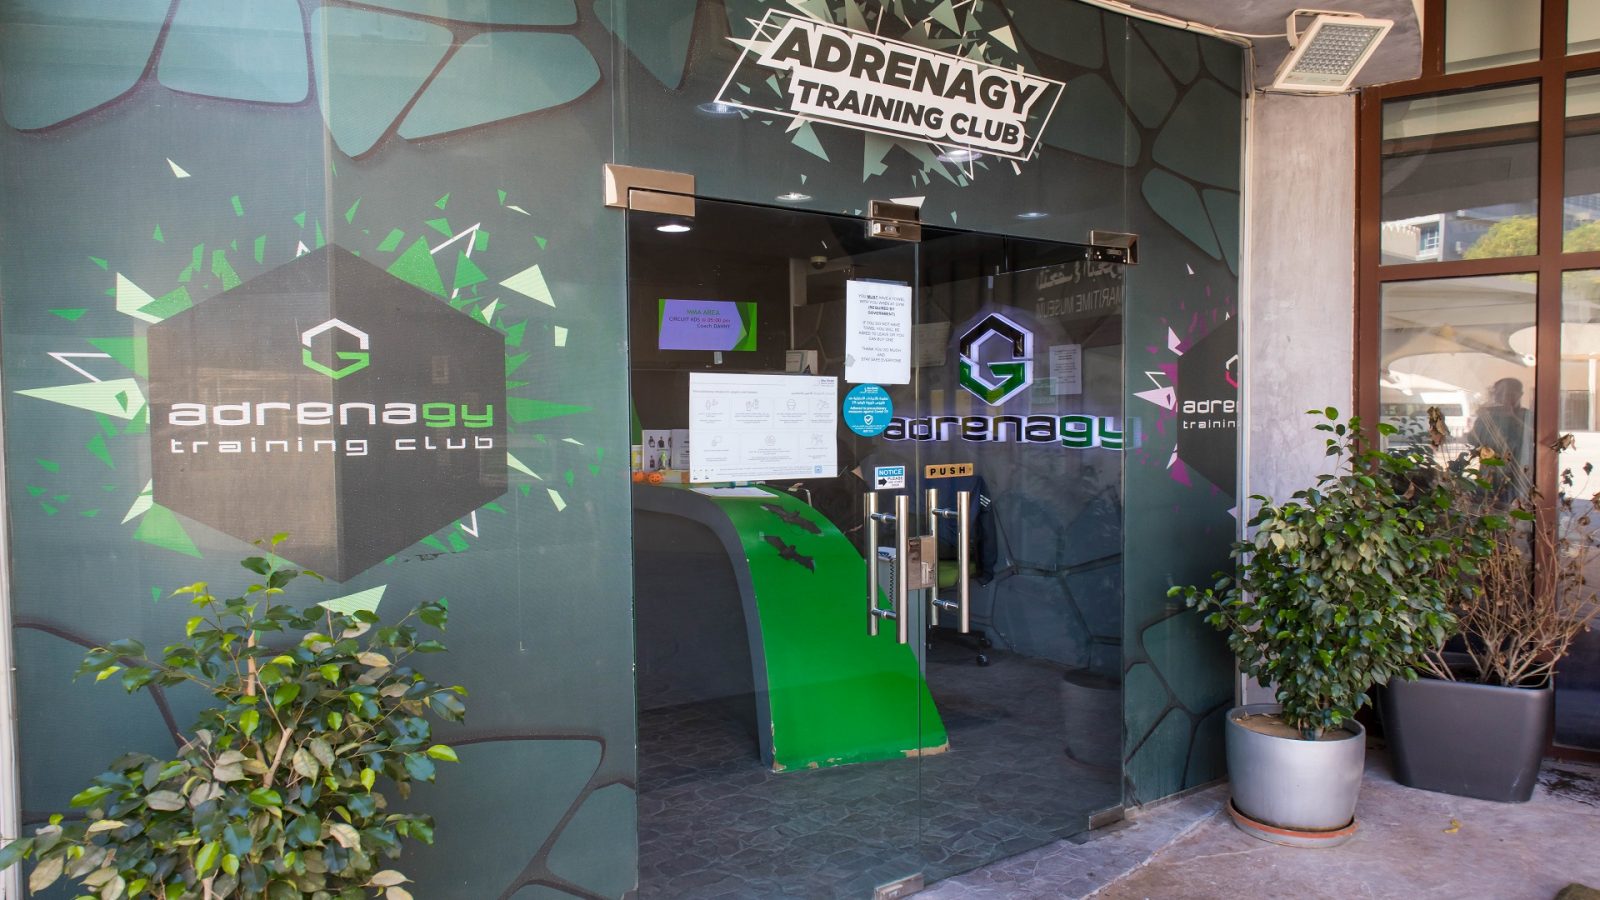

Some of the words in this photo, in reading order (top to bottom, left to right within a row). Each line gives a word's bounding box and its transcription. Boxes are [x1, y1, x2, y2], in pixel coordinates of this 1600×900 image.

[770, 25, 1039, 115] ADRENAGY
[797, 80, 944, 130] TRAINING
[950, 112, 1020, 145] CLUB
[168, 402, 494, 428] adrenagy
[1182, 400, 1238, 414] adre
[882, 414, 1141, 450] adrenagy
[170, 436, 368, 456] training
[395, 436, 493, 450] club
[930, 467, 966, 476] PUSH
